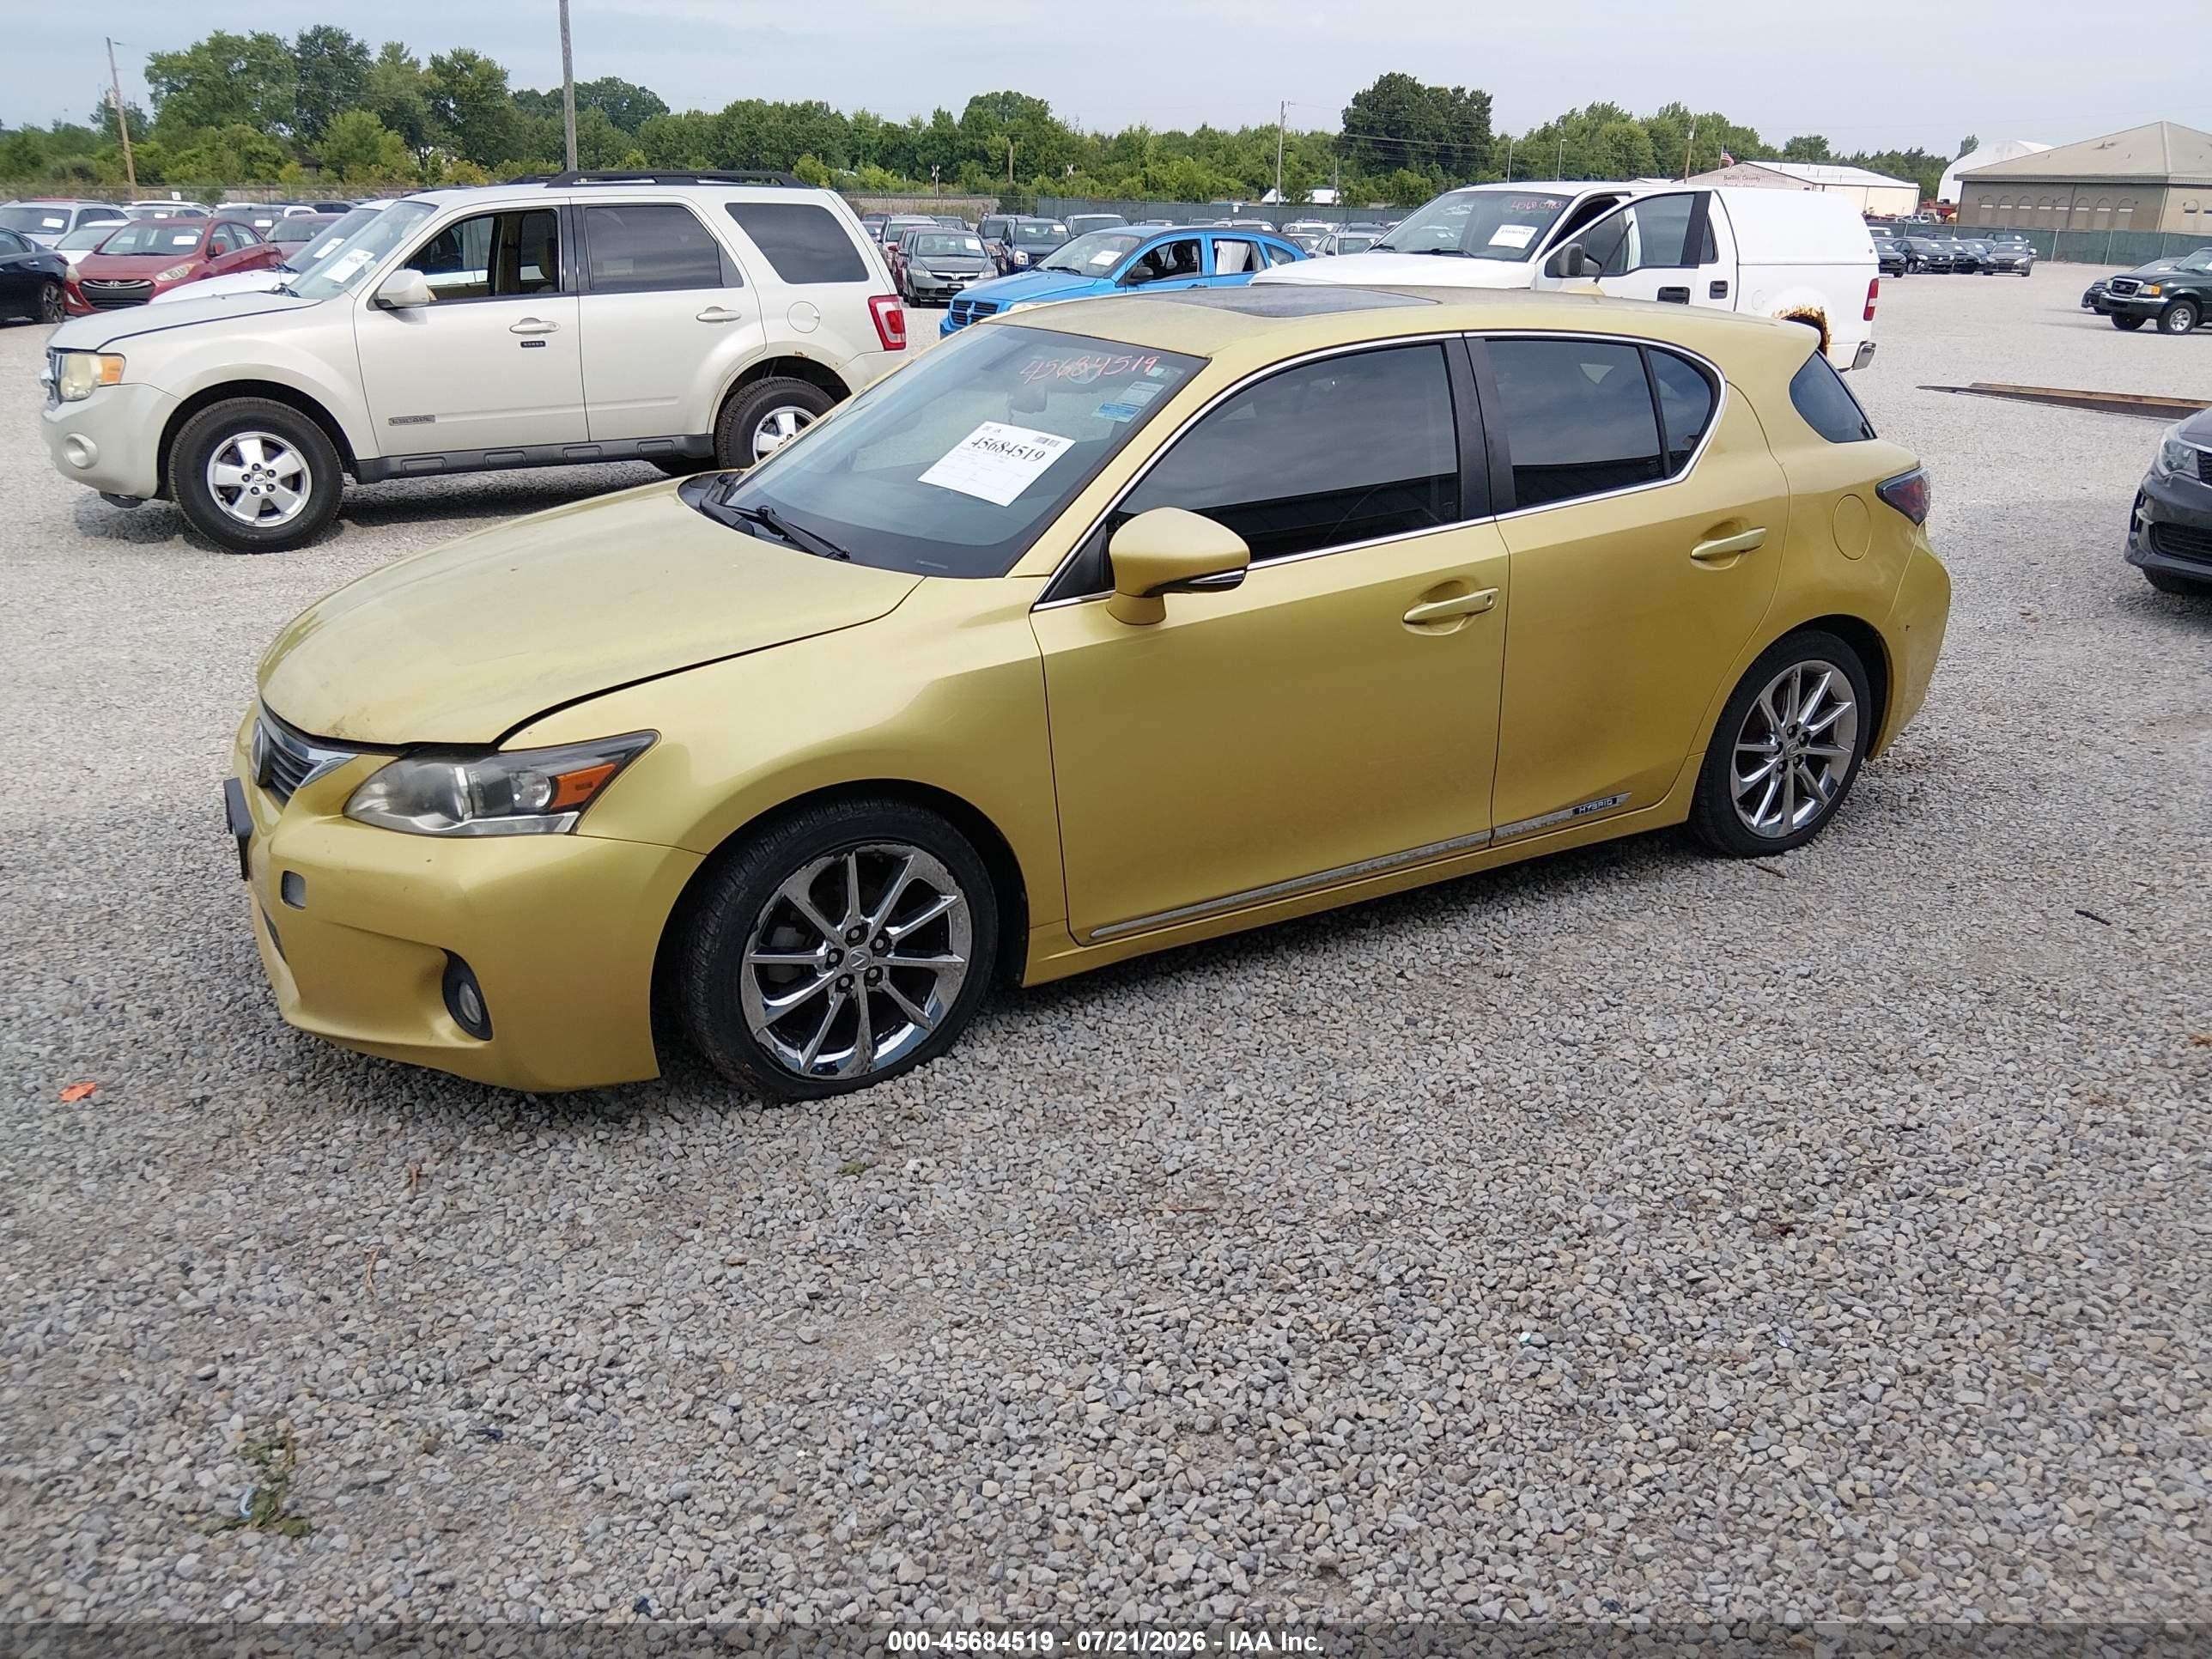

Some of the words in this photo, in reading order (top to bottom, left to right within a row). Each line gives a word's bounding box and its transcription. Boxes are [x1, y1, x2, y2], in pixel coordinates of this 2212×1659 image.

[1019, 355, 1161, 385] 45684519
[392, 416, 434, 426] ESCAPE
[970, 436, 1047, 463] 45684519
[1578, 799, 1613, 814] HYBRID
